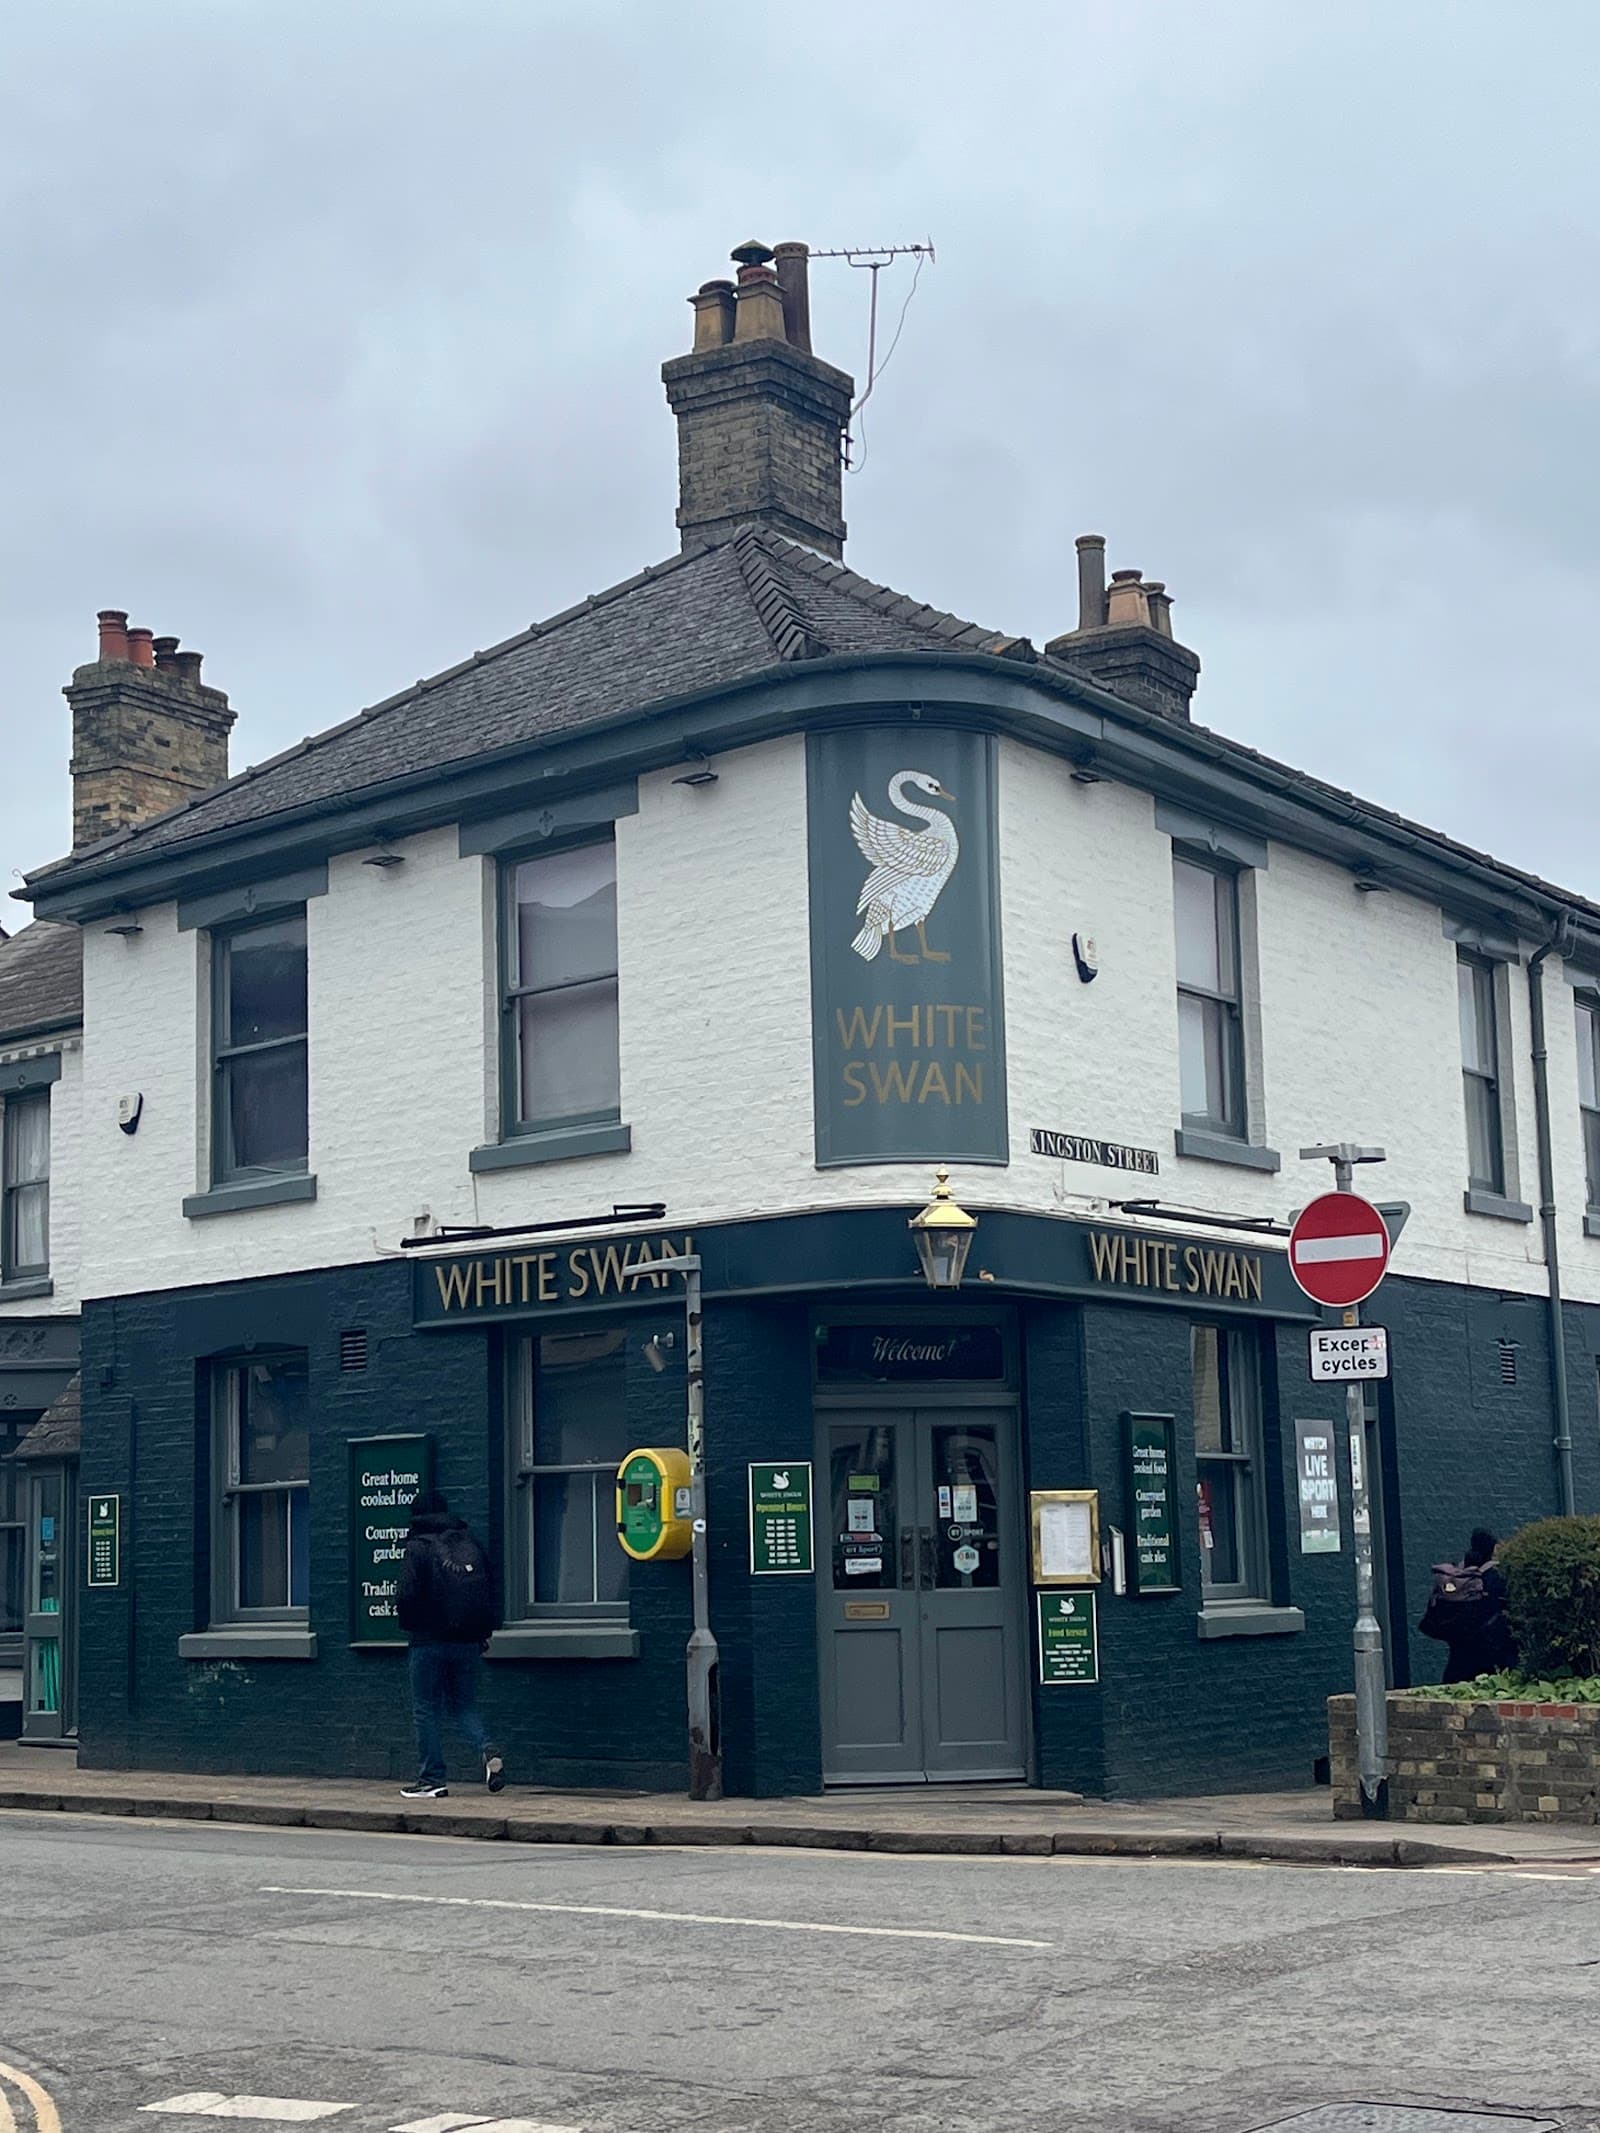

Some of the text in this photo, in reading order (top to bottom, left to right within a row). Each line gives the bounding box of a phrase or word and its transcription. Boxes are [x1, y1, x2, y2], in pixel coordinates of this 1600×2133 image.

[836, 1004, 986, 1049] WHITE
[843, 1060, 983, 1106] SWAN
[1107, 1145, 1158, 1174] STREET
[435, 1236, 692, 1311] WHITE SWAN
[1090, 1231, 1262, 1302] WHITE SWAN
[872, 1336, 957, 1363] Welcome!
[1322, 1356, 1377, 1374] cycles
[1304, 1455, 1329, 1477] LIVE
[361, 1469, 419, 1487] Great home
[361, 1488, 420, 1506] cooked foo
[1301, 1480, 1335, 1501] SPORT
[365, 1526, 410, 1542] Courtyar
[369, 1600, 391, 1617] cask
